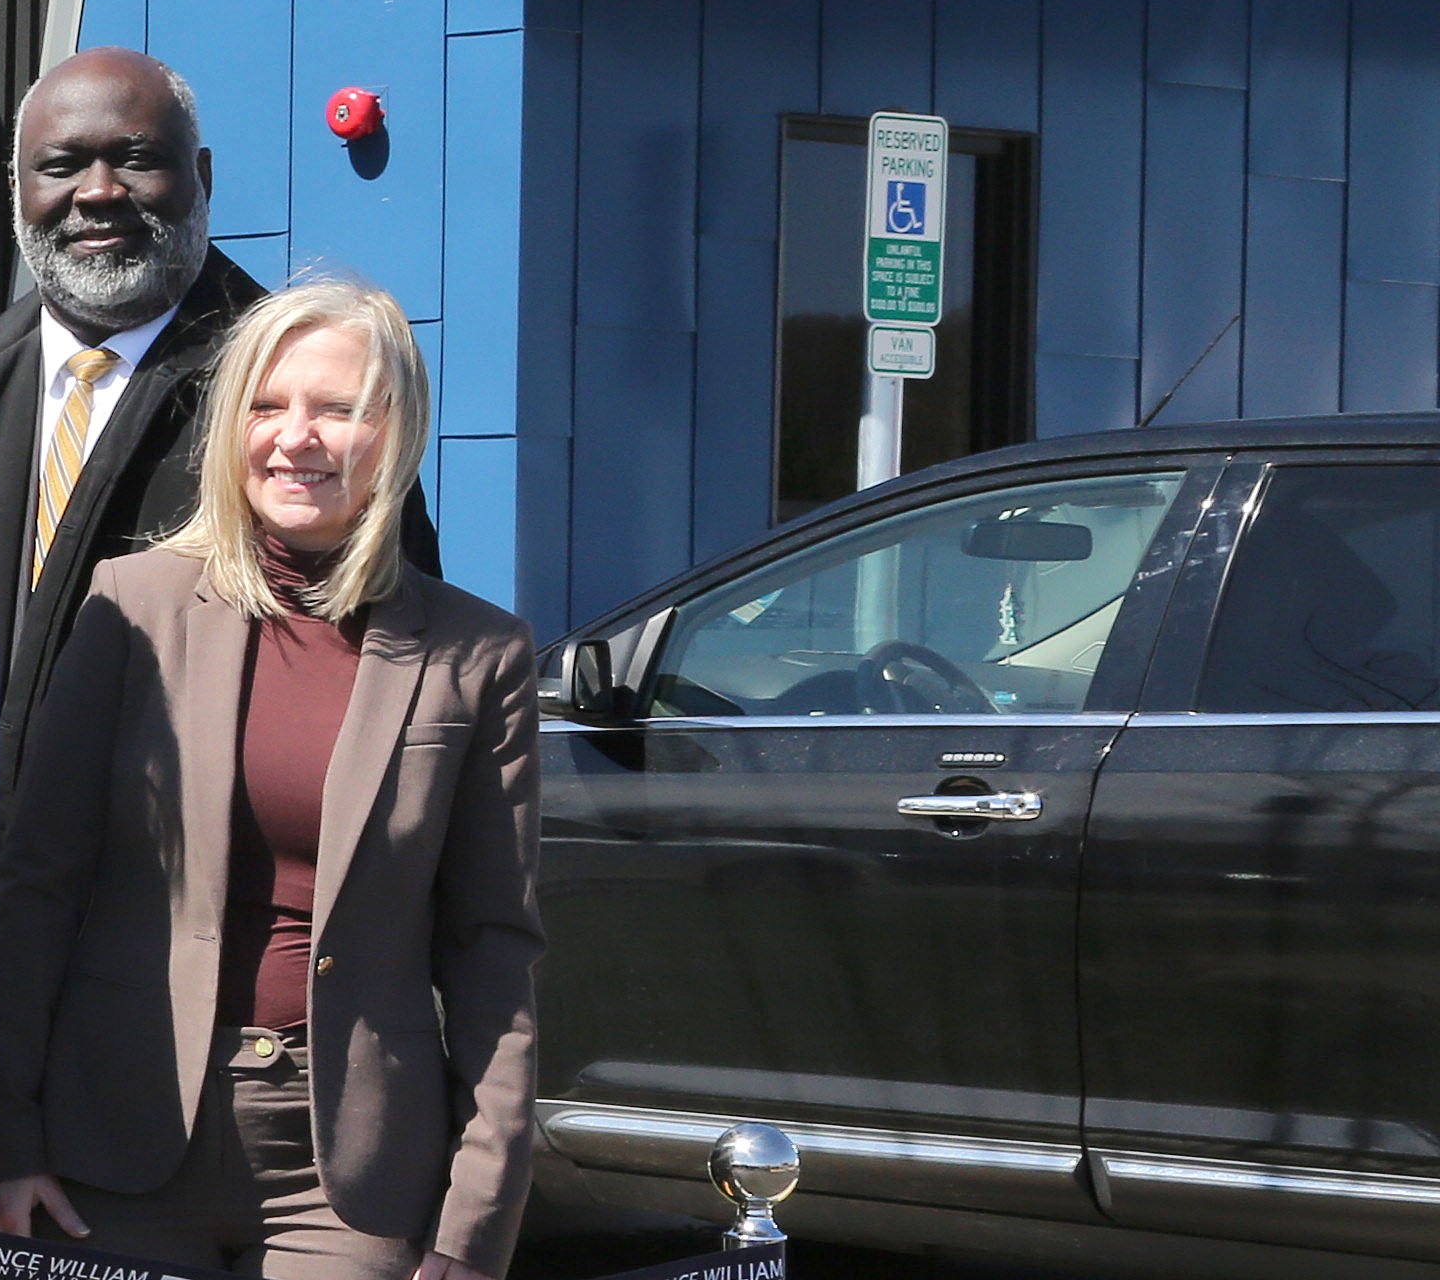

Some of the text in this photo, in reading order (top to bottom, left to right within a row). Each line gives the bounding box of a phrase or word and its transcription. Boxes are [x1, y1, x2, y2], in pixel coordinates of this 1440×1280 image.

[877, 130, 941, 152] RESERVED
[882, 156, 934, 179] PARKING
[891, 337, 913, 351] VAN
